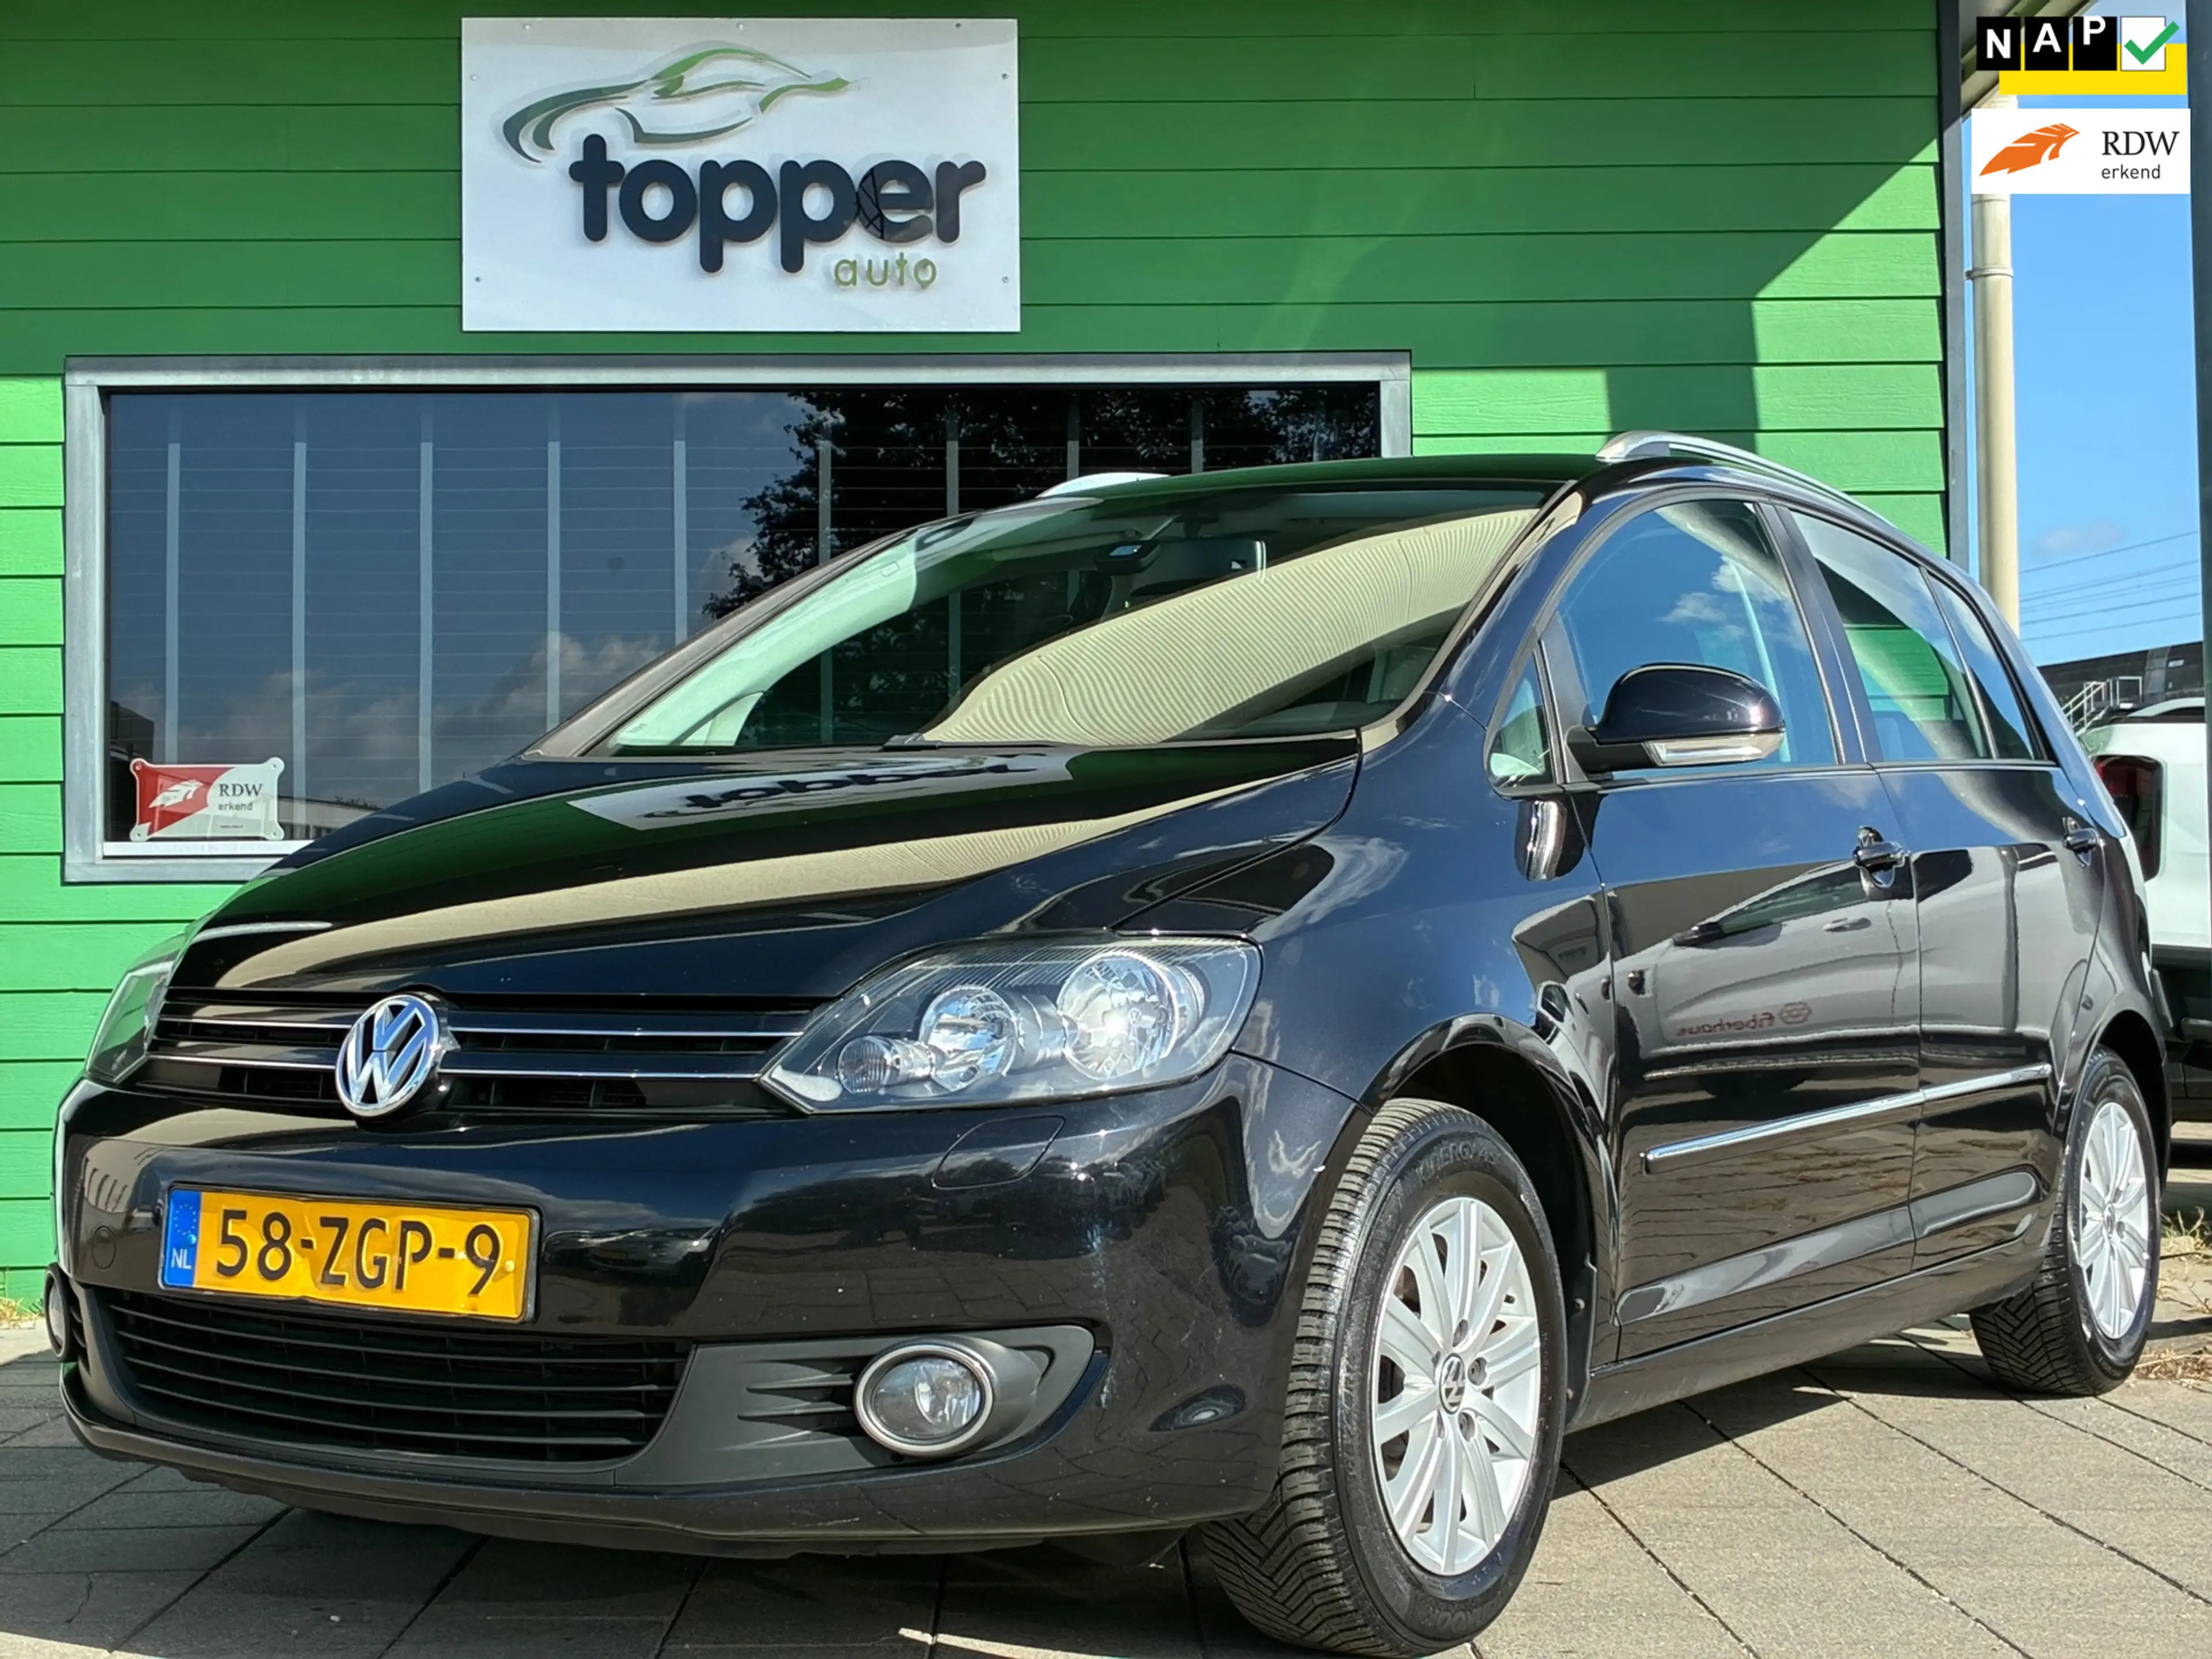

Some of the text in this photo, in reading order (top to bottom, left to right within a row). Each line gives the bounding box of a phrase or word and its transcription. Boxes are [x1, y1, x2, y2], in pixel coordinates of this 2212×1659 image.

[569, 133, 987, 274] topper
[834, 252, 937, 289] auto
[218, 783, 264, 797] RDW
[218, 801, 253, 811] erkend
[172, 1248, 192, 1270] NL
[217, 1207, 501, 1297] 58-ZGP-9
